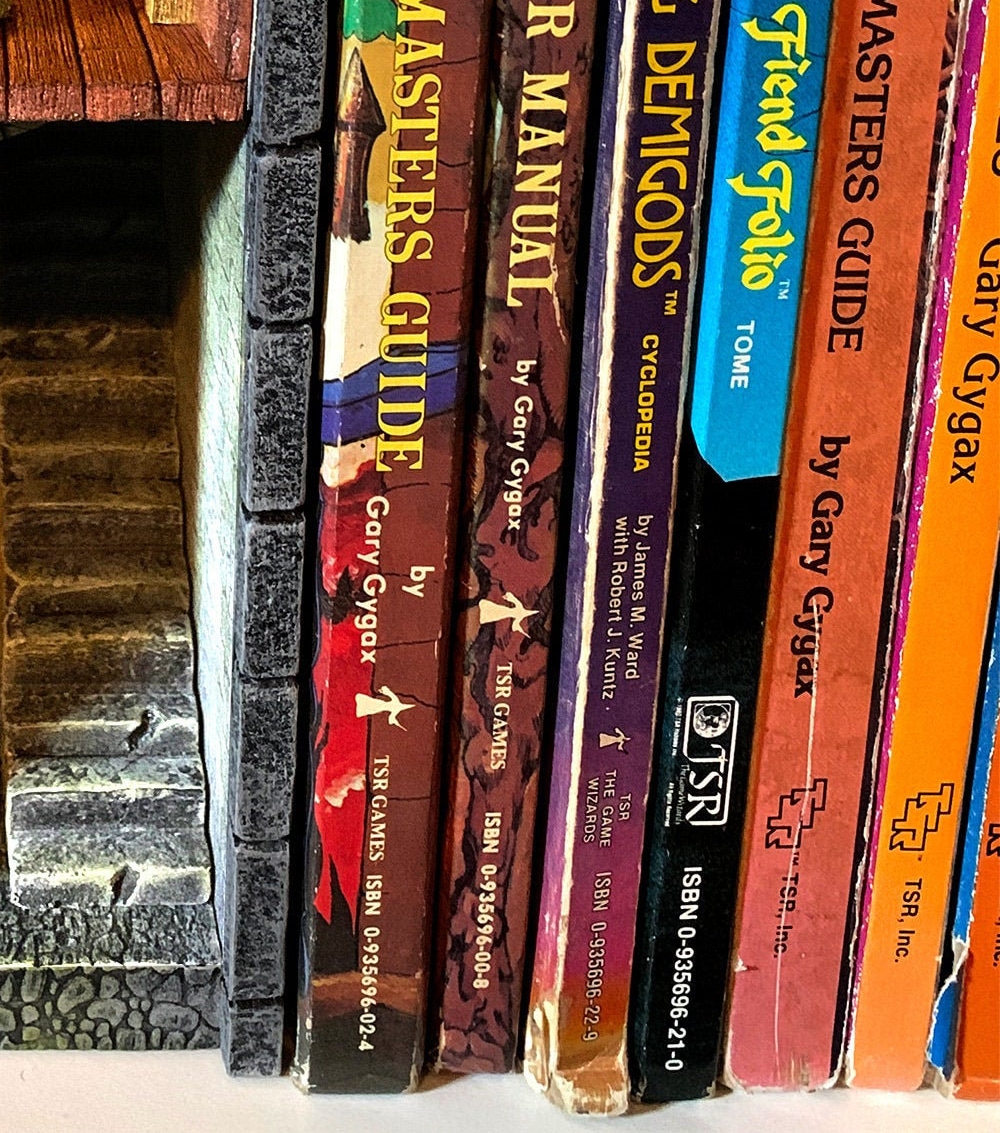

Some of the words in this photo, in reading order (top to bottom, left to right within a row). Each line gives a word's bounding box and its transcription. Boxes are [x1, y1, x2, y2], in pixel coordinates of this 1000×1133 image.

[740, 2, 812, 151] Fiend
[506, 69, 571, 307] MANUAL
[827, 217, 875, 353] GUIDE
[962, 237, 1000, 338] Gary
[375, 291, 430, 472] GUIDE
[510, 359, 537, 386] by
[729, 320, 755, 390] TOME
[506, 396, 533, 452] Gary
[633, 334, 659, 473] CYCLOPEDIA
[948, 352, 1000, 484] Gygax
[808, 435, 851, 480] by
[503, 458, 529, 531] Gygax
[357, 496, 389, 565] Gary
[612, 516, 630, 556] with
[633, 515, 653, 540] by
[799, 489, 844, 577] Gary
[402, 566, 435, 597] by
[607, 561, 628, 623] Robert
[631, 542, 650, 601] James
[354, 573, 386, 664] Gygax
[606, 626, 623, 643] J.
[629, 606, 645, 629] M.
[789, 586, 834, 699] Gygax
[495, 662, 512, 699] TSR
[602, 647, 621, 700] Kuntz
[625, 631, 644, 680] Ward
[490, 703, 510, 770] GAMES
[372, 755, 390, 790] TSR
[604, 769, 617, 798] THE
[685, 743, 728, 821] TSR
[369, 793, 388, 863] GAMES
[482, 812, 501, 854] ISBN
[583, 777, 600, 843] WIZARDS
[599, 805, 614, 847] GAME
[618, 793, 632, 822] TSR
[365, 874, 383, 916] ISBN
[592, 871, 612, 912] ISBN
[679, 867, 702, 920] ISBN
[896, 878, 922, 922] TSR,
[473, 864, 497, 989] 0-935696-00-8
[772, 925, 793, 958] Inc.
[894, 930, 916, 963] Inc.
[358, 927, 380, 1052] 0-935696-02-4
[582, 922, 607, 1041] 0-935696-22-9
[664, 927, 697, 1071] 0-935696-21-0
